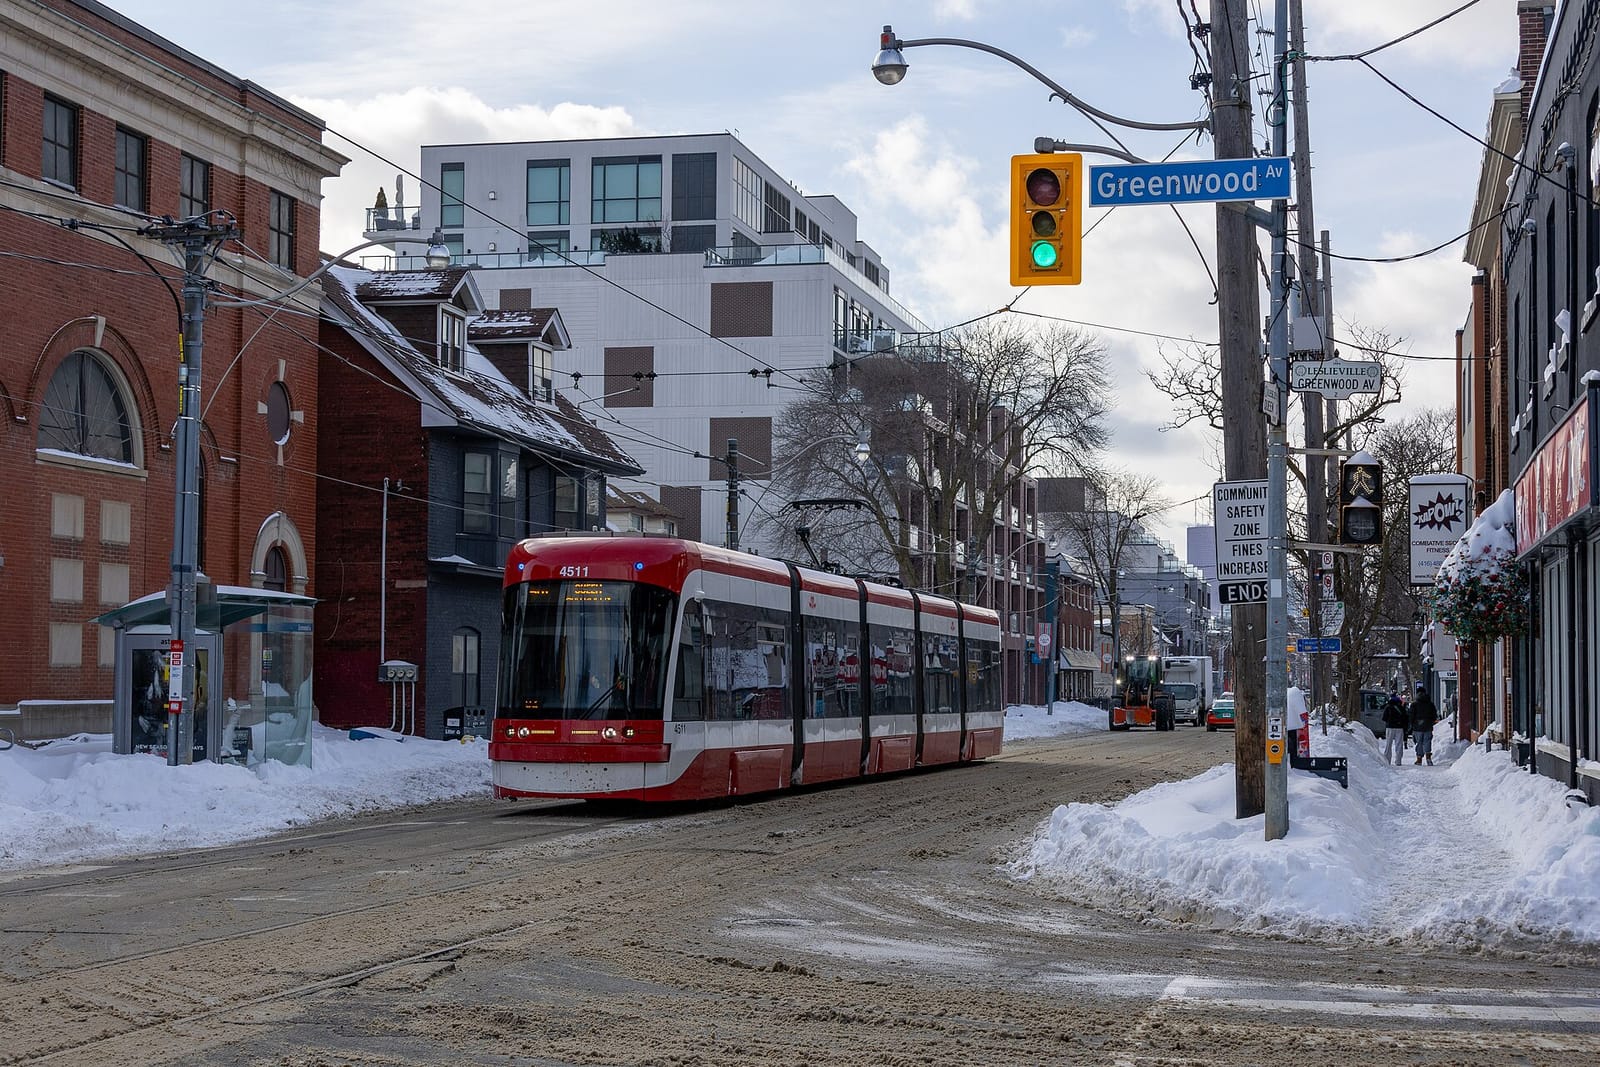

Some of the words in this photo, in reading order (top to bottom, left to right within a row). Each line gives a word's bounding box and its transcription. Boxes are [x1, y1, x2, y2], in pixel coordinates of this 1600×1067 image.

[1097, 165, 1258, 199] Greenwood
[1265, 163, 1283, 179] Av
[1307, 366, 1366, 376] LESLIEVILLE
[1297, 378, 1359, 390] GREENWOOD
[1217, 486, 1268, 502] COMMUNIT
[1226, 504, 1265, 519] SAFETY
[1233, 523, 1261, 537] ZONE
[1232, 543, 1263, 557] FINES
[559, 566, 589, 577] 4511
[1219, 561, 1268, 576] INCREASE
[674, 723, 686, 734] 4511
